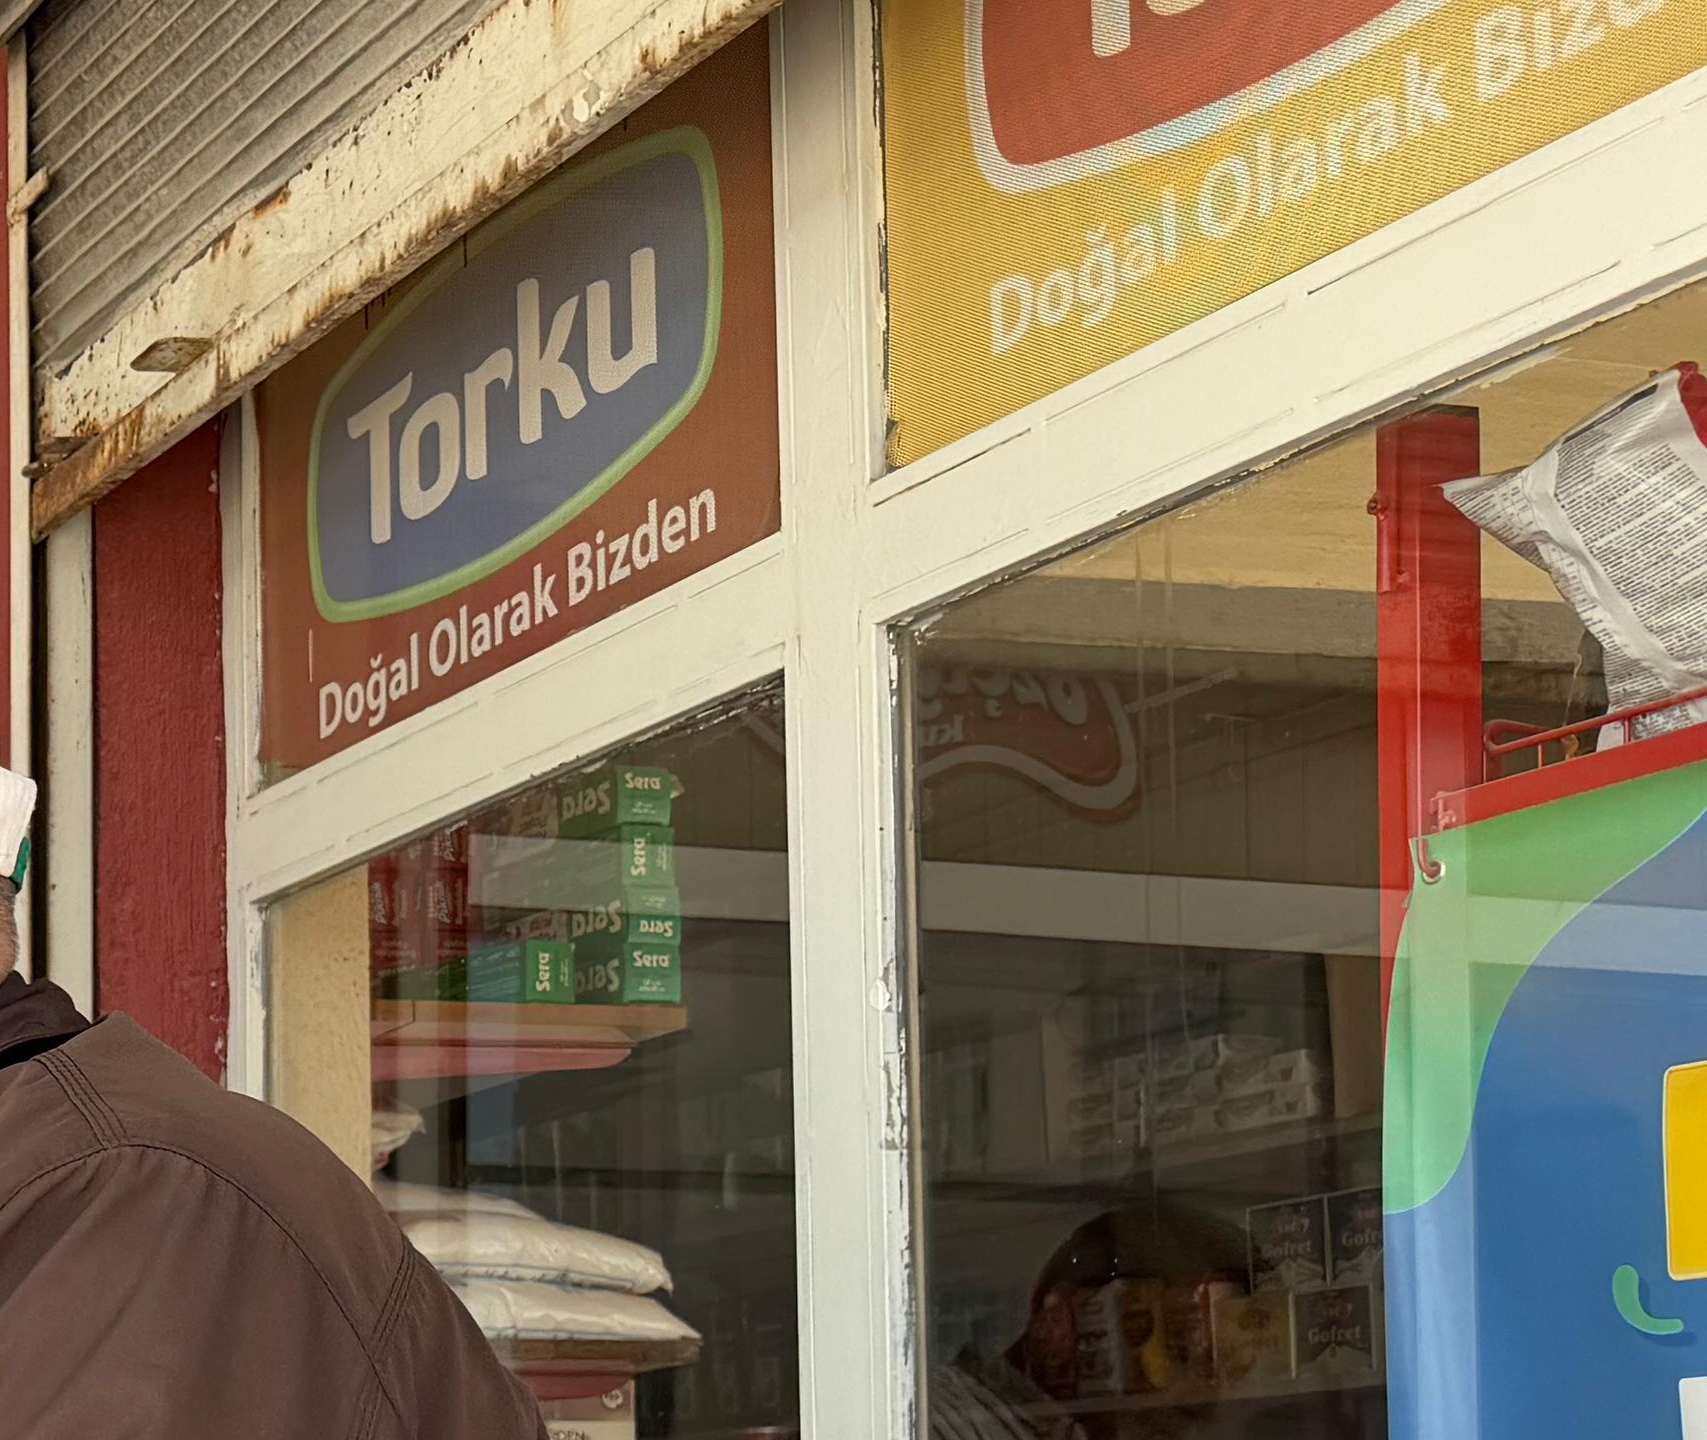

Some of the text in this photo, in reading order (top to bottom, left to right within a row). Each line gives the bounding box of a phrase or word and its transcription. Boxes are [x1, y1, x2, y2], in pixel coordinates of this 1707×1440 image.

[988, 0, 1667, 354] Doğal Olarak Biz
[347, 248, 658, 545] Torku
[318, 487, 717, 739] Doğal Olarak Bizden
[625, 772, 661, 790] Sera
[630, 837, 647, 877] Sera
[535, 952, 551, 992] Sera
[633, 951, 671, 969] Sera
